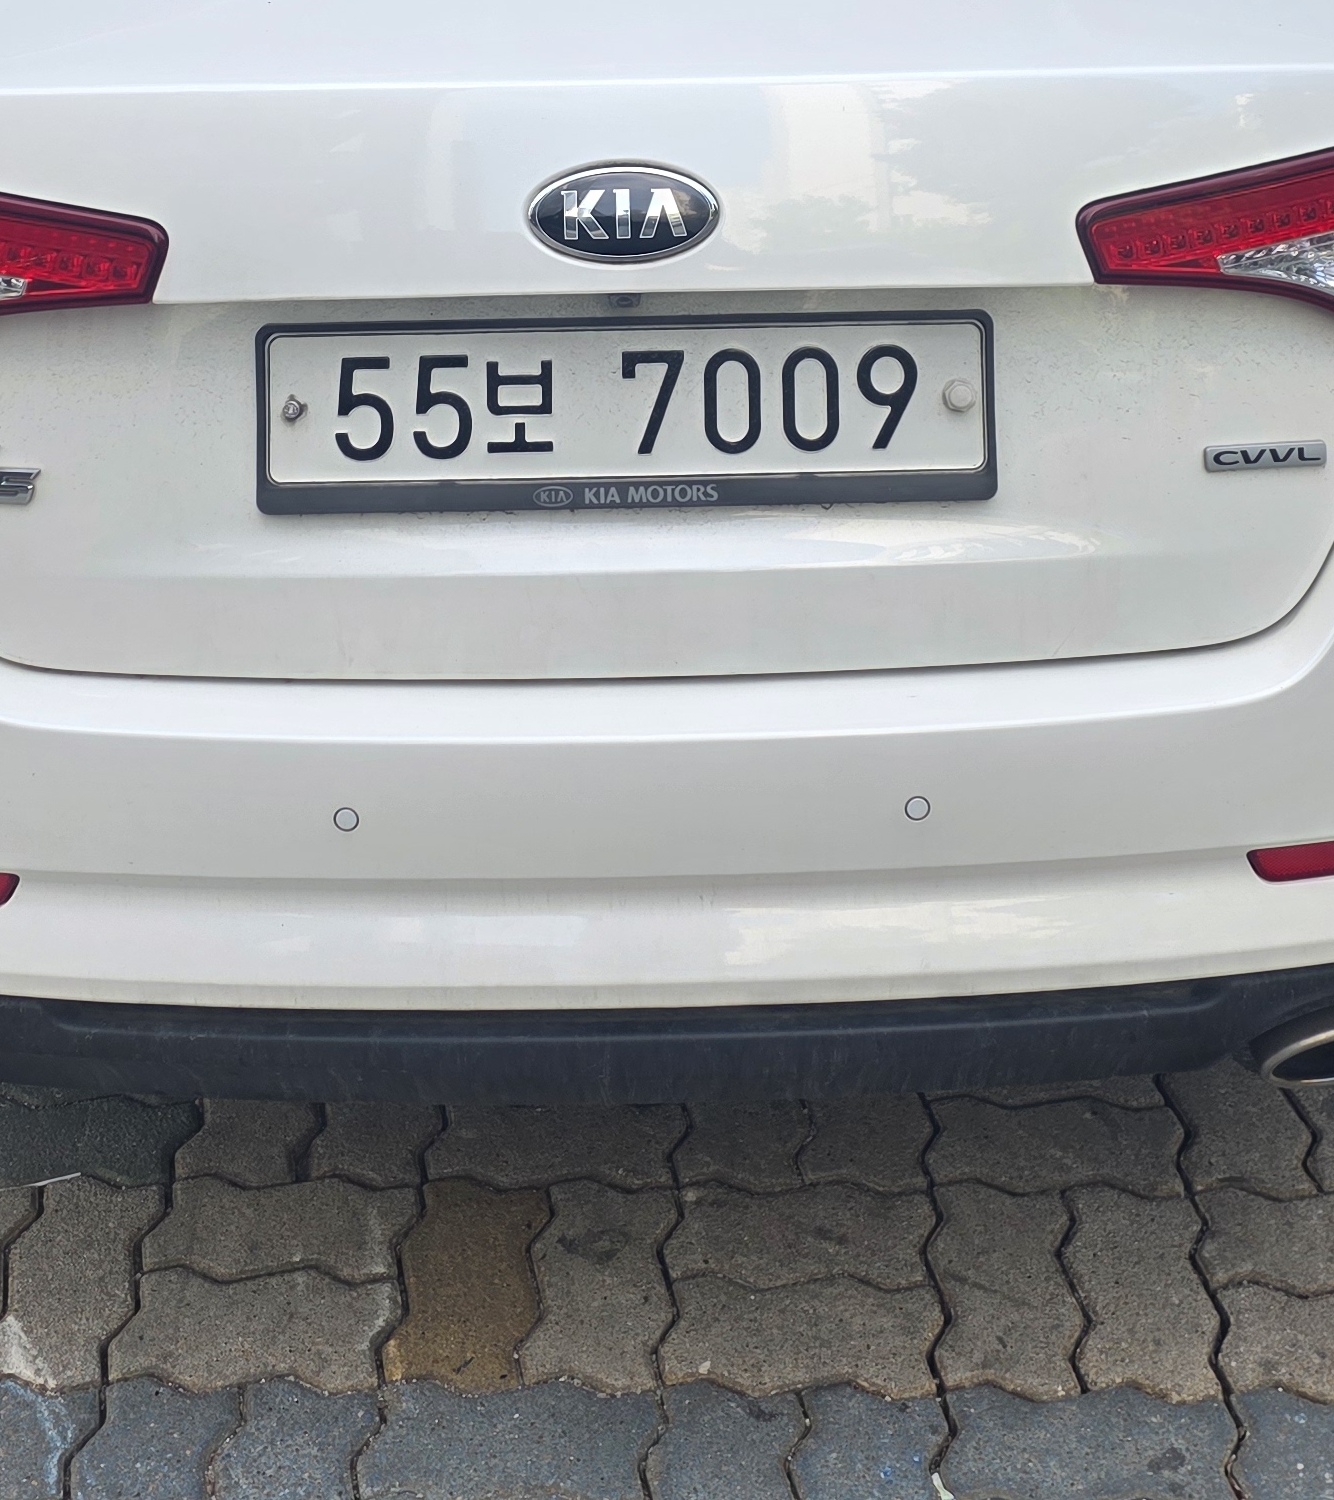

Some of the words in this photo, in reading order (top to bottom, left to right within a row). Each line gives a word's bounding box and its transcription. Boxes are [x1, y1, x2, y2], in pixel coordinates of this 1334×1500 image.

[560, 187, 689, 242] KIA
[334, 353, 555, 462] 55보
[620, 343, 920, 455] 7009
[1213, 447, 1321, 466] CVVL
[540, 490, 568, 503] KIA
[584, 486, 621, 505] KIA
[628, 483, 719, 504] MOTORS
